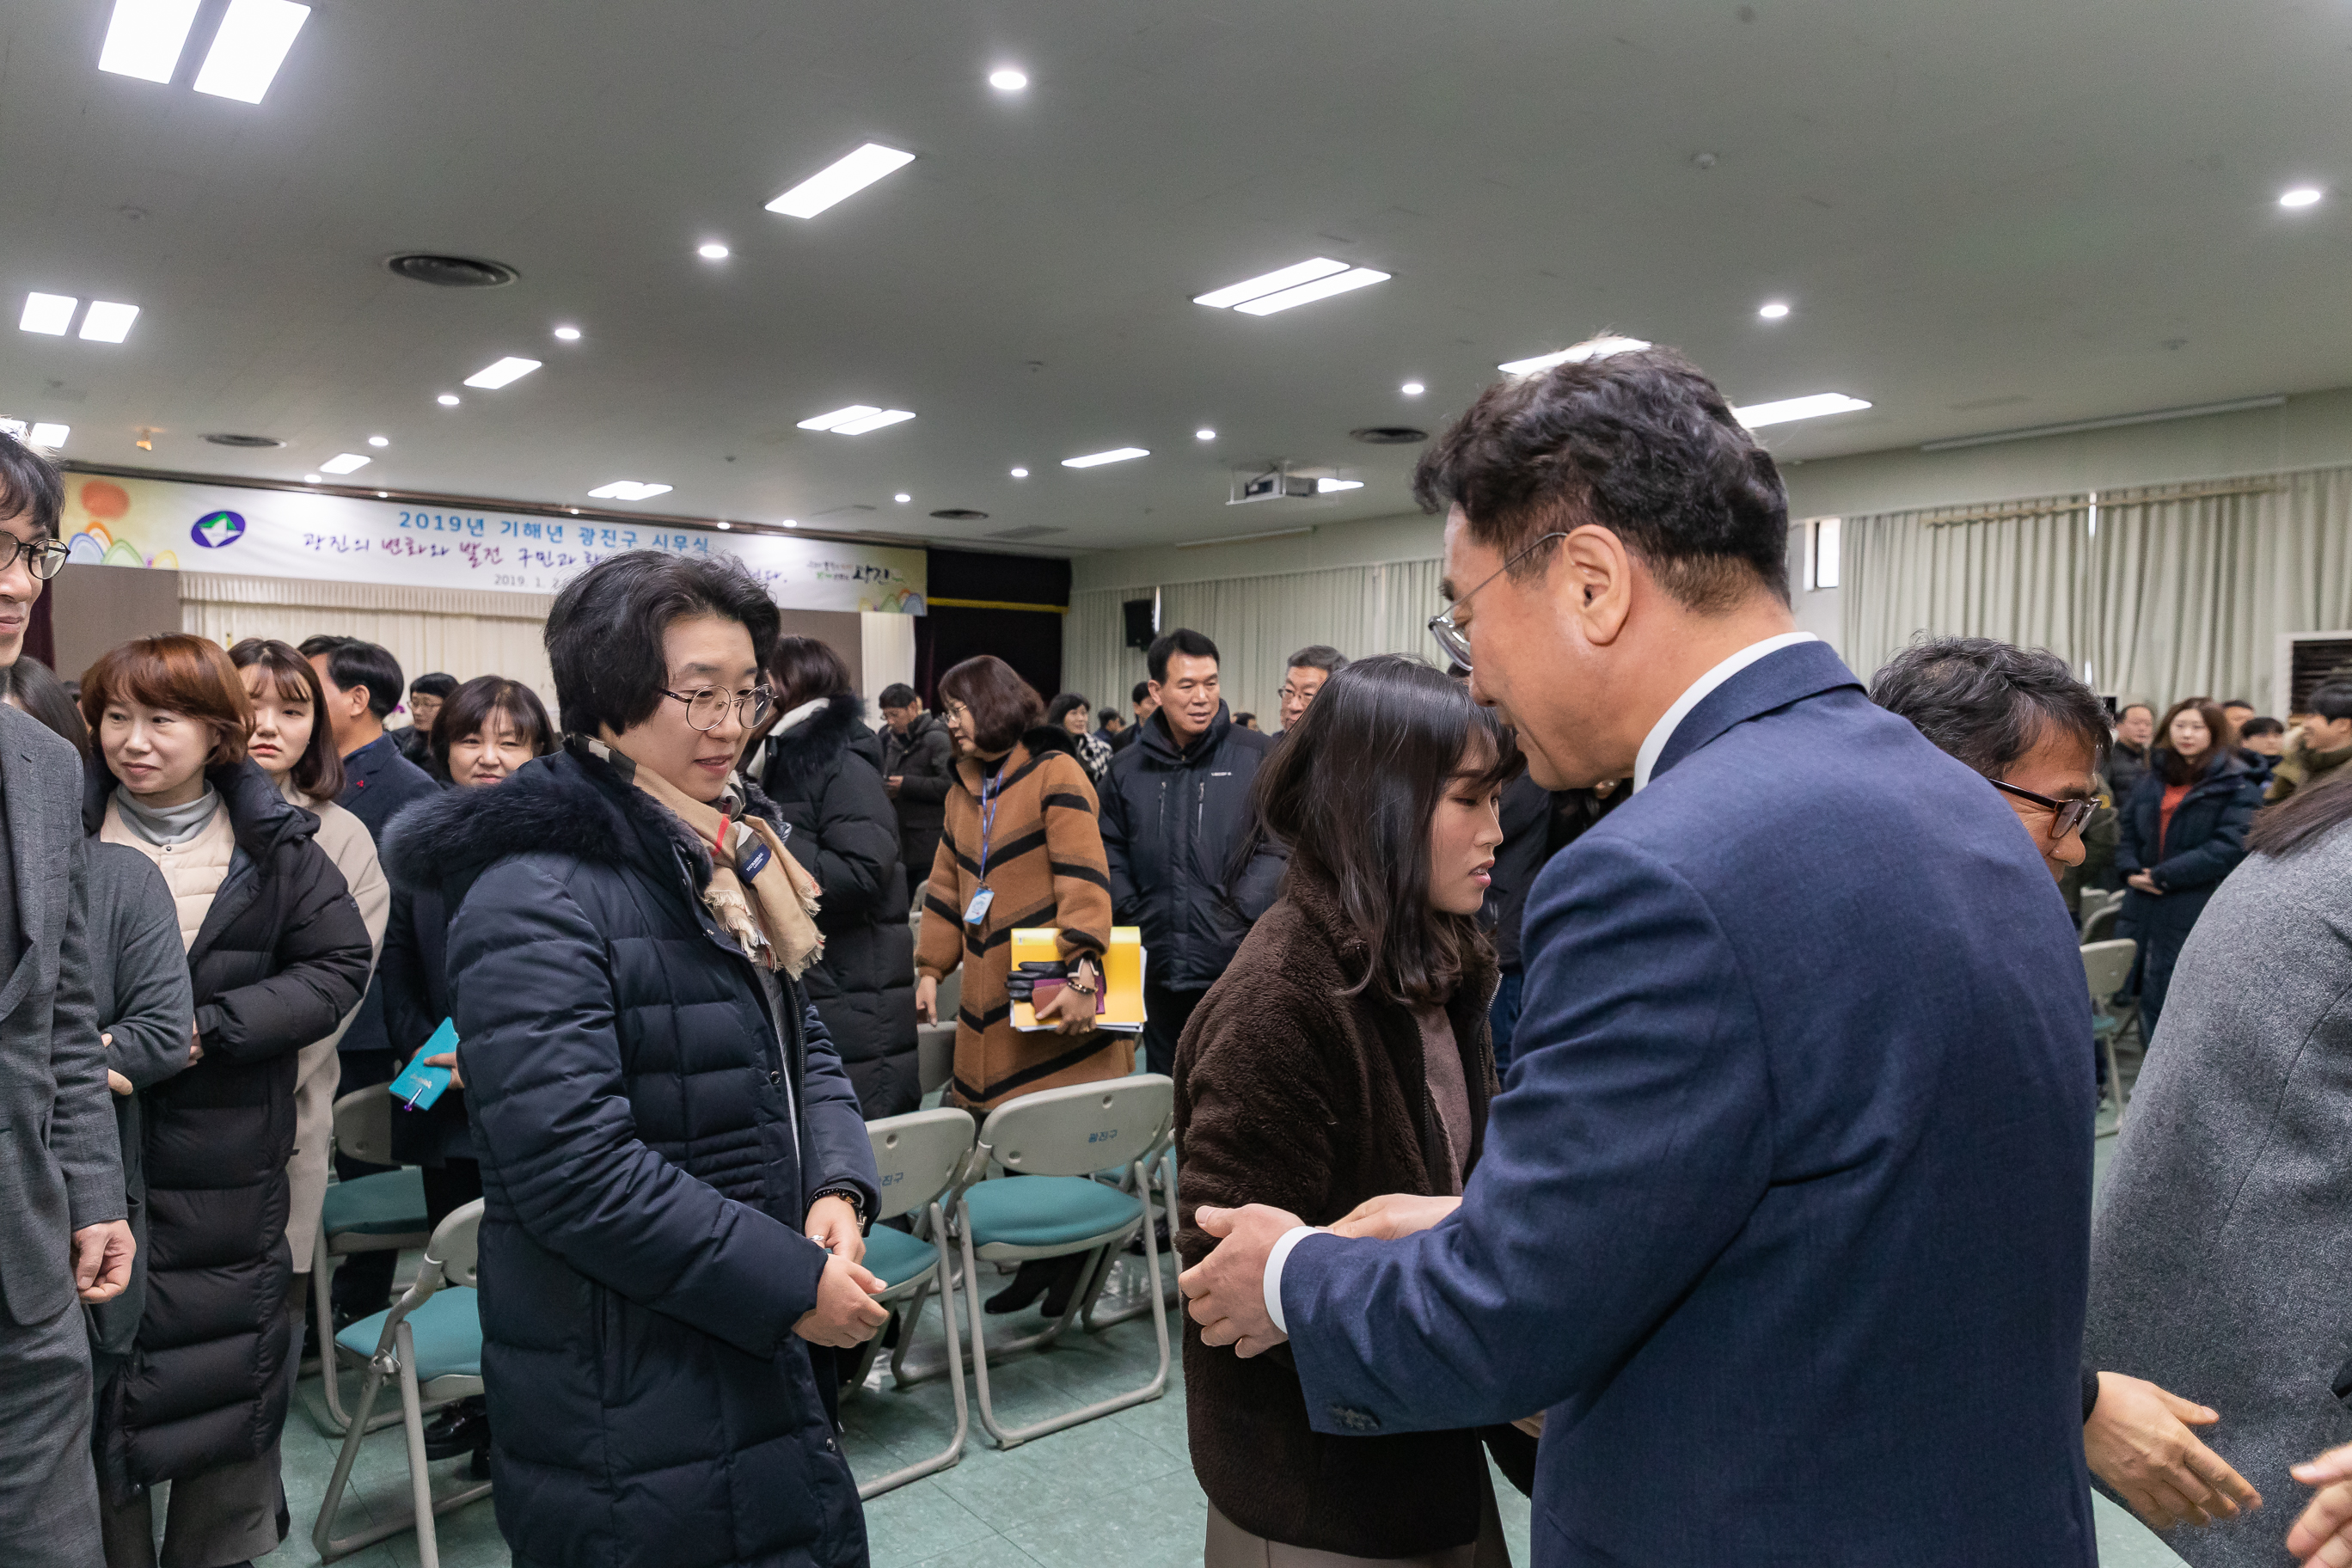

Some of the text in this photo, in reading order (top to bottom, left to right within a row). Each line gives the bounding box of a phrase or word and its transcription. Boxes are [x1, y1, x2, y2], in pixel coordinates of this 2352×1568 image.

[303, 533, 370, 554] 광진의
[381, 536, 450, 558] 변화와
[458, 541, 504, 569] 발전
[518, 547, 577, 568] 구민과
[399, 511, 709, 557] 2019년 기해년 광진구 시무식
[879, 1172, 904, 1186] 진구
